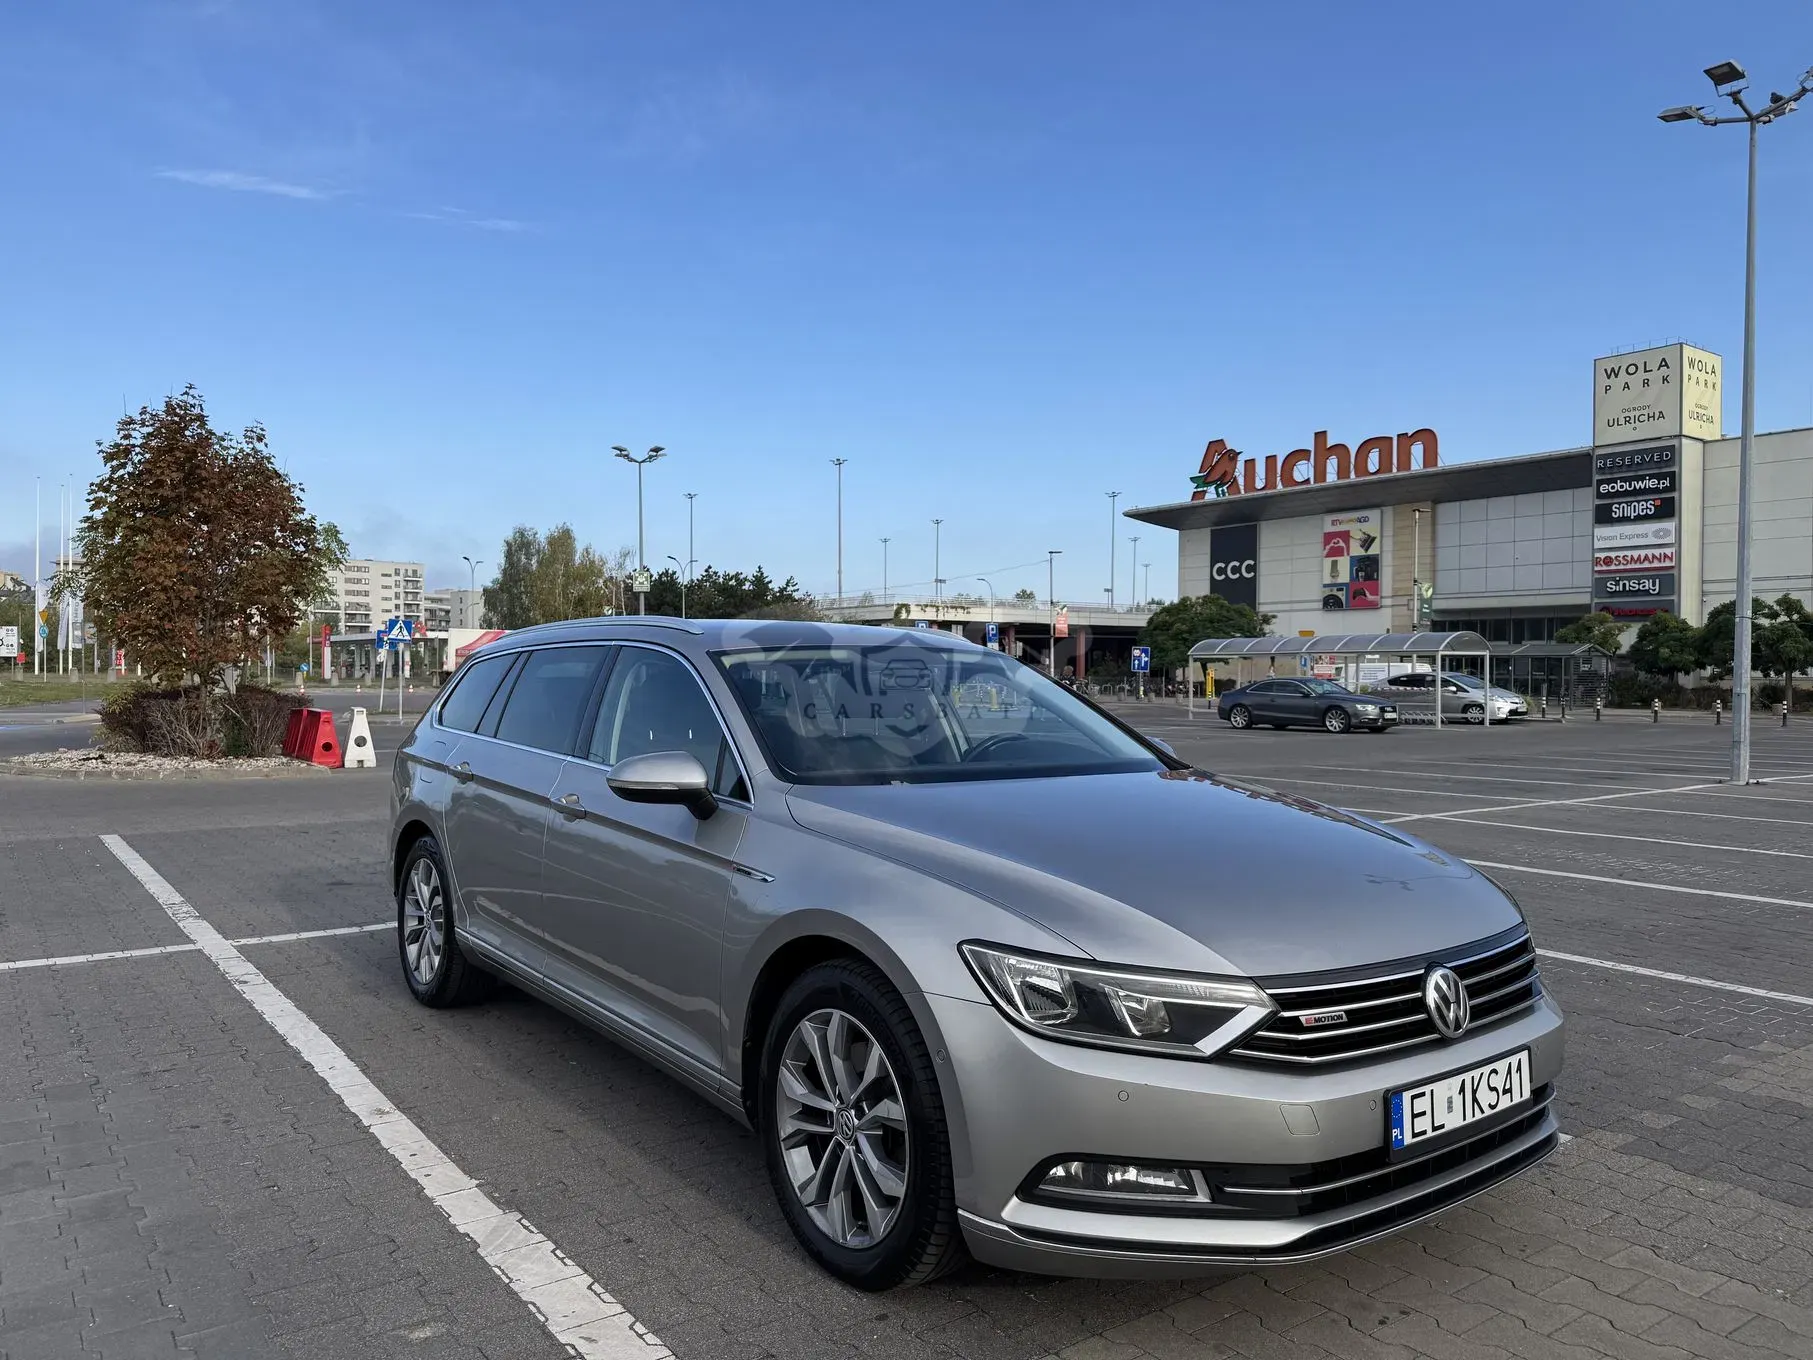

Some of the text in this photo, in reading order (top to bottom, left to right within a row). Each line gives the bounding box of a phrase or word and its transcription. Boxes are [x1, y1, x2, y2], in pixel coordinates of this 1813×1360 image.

[1604, 357, 1670, 380] WOLA
[1687, 356, 1717, 377] WOLA
[1604, 374, 1670, 395] PARK
[1687, 374, 1717, 391] PARK
[1621, 403, 1652, 414] OGRODY
[1688, 409, 1714, 425] ULRICHA
[1607, 410, 1666, 428] ULRICHA
[1190, 428, 1438, 502] Auchan
[1597, 451, 1671, 469] RESERVED
[1599, 476, 1670, 493] eobuwie.pl
[1611, 500, 1655, 519] snipes
[1596, 531, 1649, 543] Vision Express
[1595, 551, 1674, 568] ROSSMANN
[1212, 559, 1256, 581] CCC
[1606, 576, 1660, 595] sinsay
[1410, 1057, 1523, 1139] EL 1KS41
[1392, 1128, 1403, 1142] PL
